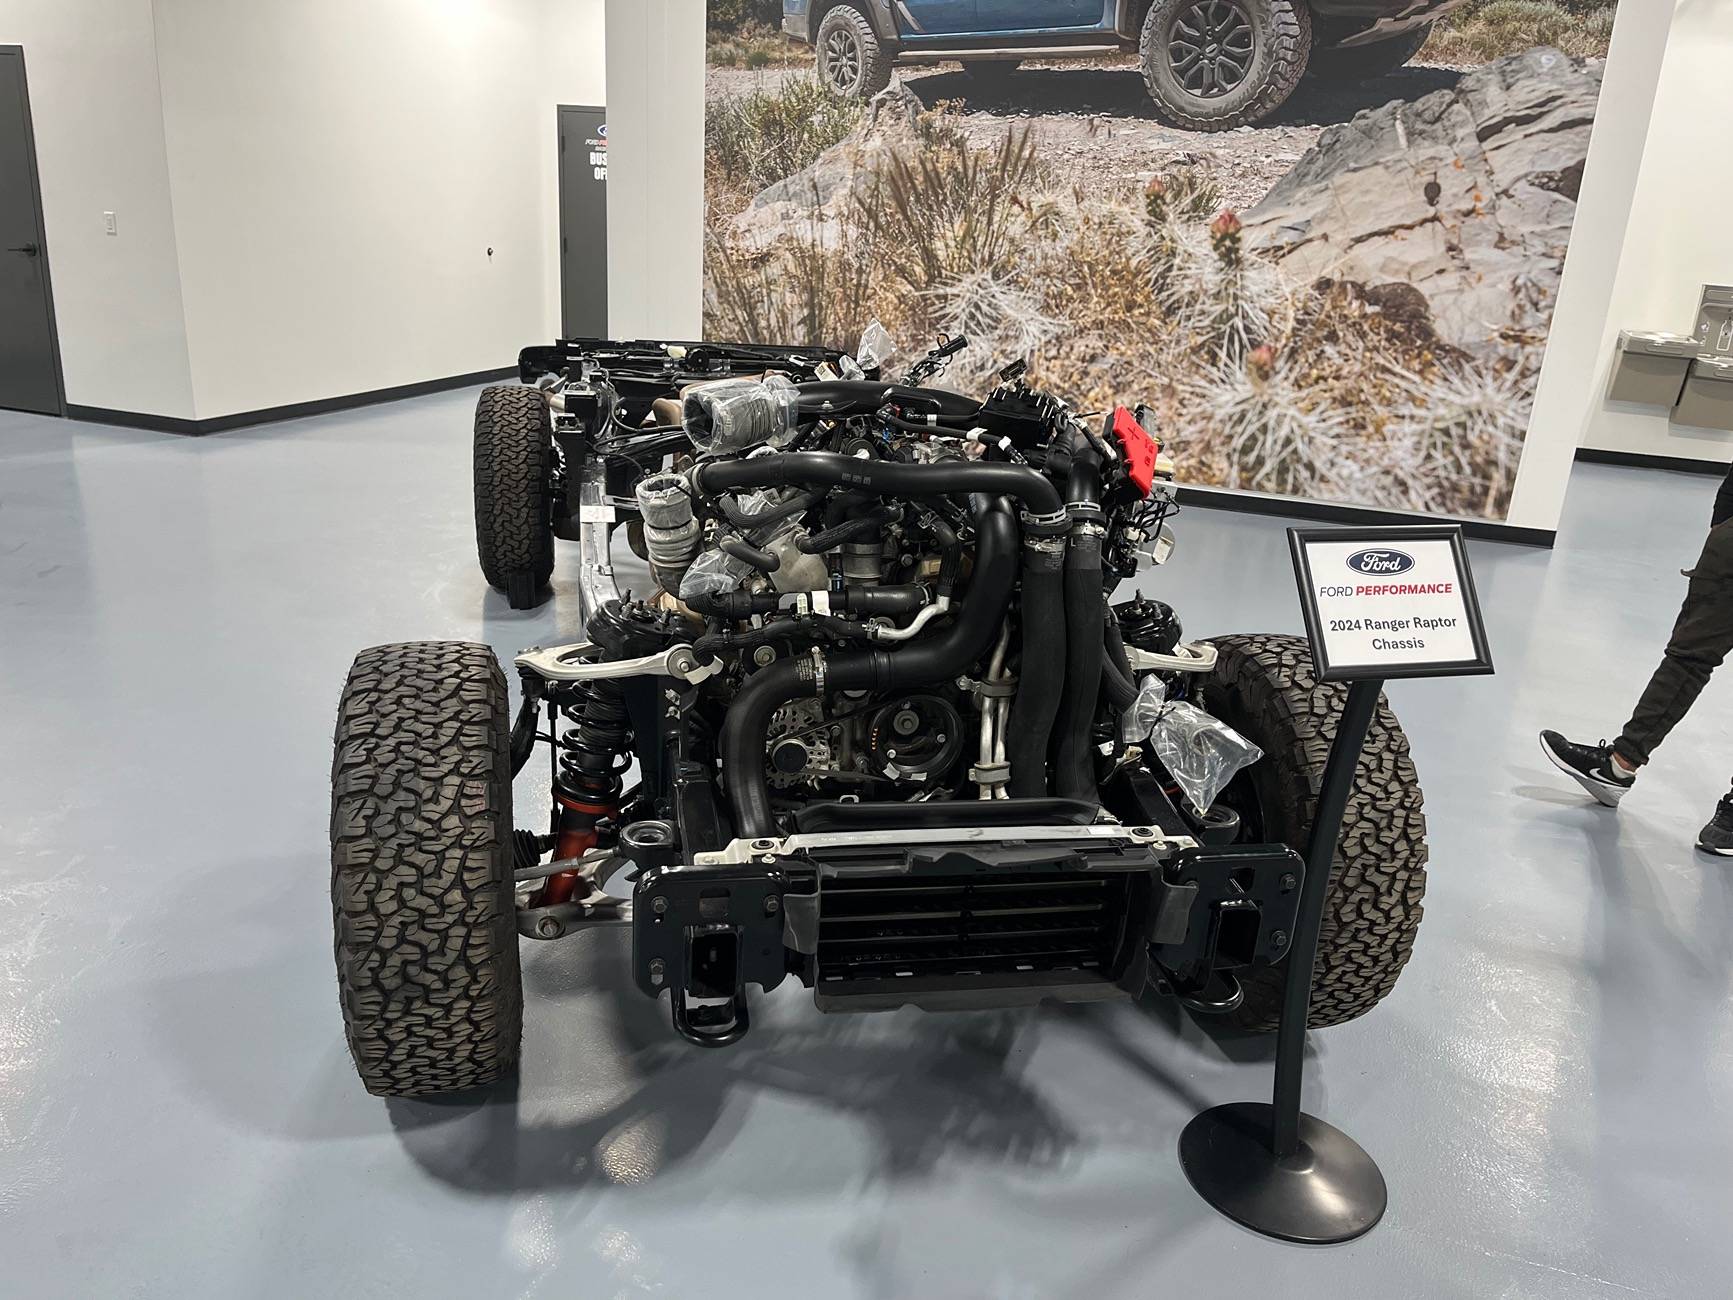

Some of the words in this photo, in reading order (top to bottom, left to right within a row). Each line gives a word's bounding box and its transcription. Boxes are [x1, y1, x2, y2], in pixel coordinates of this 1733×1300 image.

[1360, 552, 1402, 572] Ford
[1319, 586, 1354, 597] FORD
[1355, 583, 1453, 596] PERFORMANCE
[1329, 619, 1362, 632] 2024
[1364, 618, 1411, 632] Ranger
[1413, 616, 1457, 630] Raptor
[1372, 637, 1425, 650] Chassis
